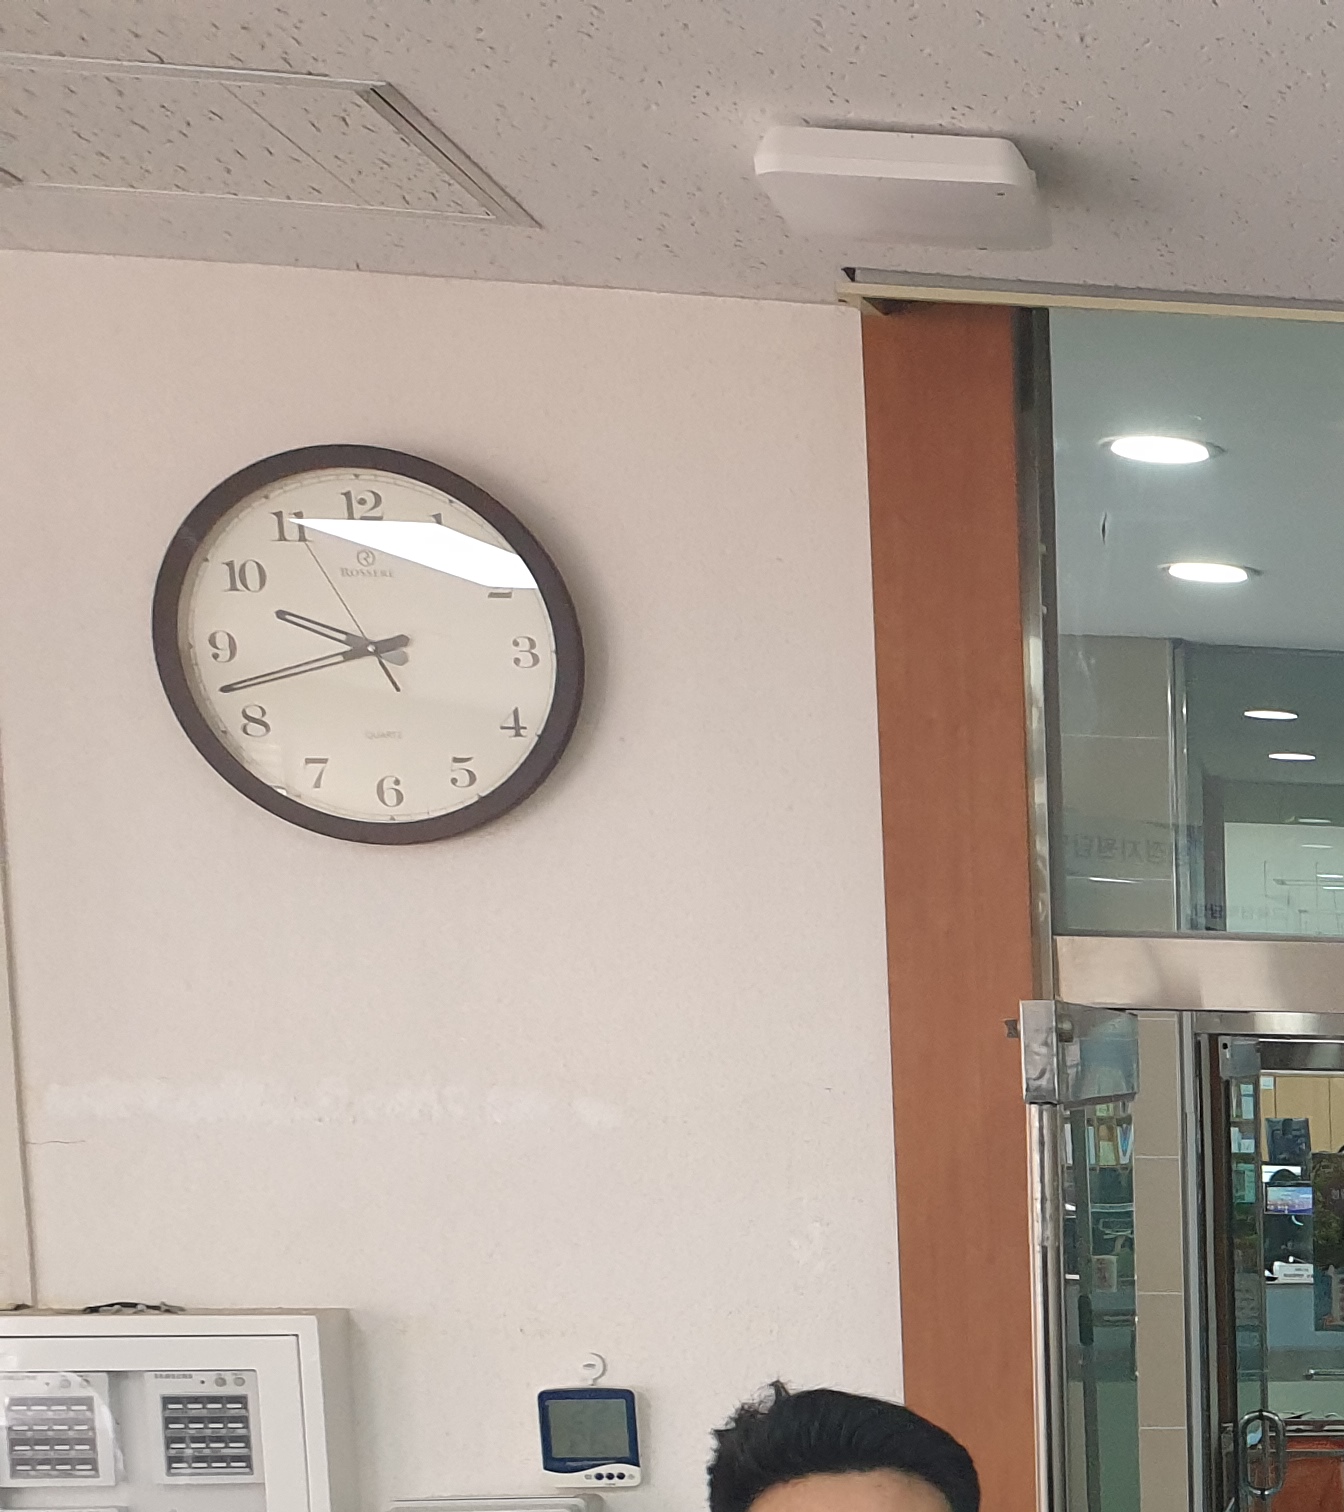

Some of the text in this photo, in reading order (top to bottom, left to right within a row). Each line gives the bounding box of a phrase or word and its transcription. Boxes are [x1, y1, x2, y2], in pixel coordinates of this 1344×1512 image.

[341, 489, 384, 520] 12
[271, 510, 312, 542] 11
[221, 559, 267, 592] 10
[208, 630, 237, 663] 9
[512, 636, 540, 669] 3
[241, 704, 271, 737] 8
[500, 707, 527, 737] 4
[304, 757, 329, 788] 7
[450, 756, 477, 788] 5
[376, 775, 404, 808] 6
